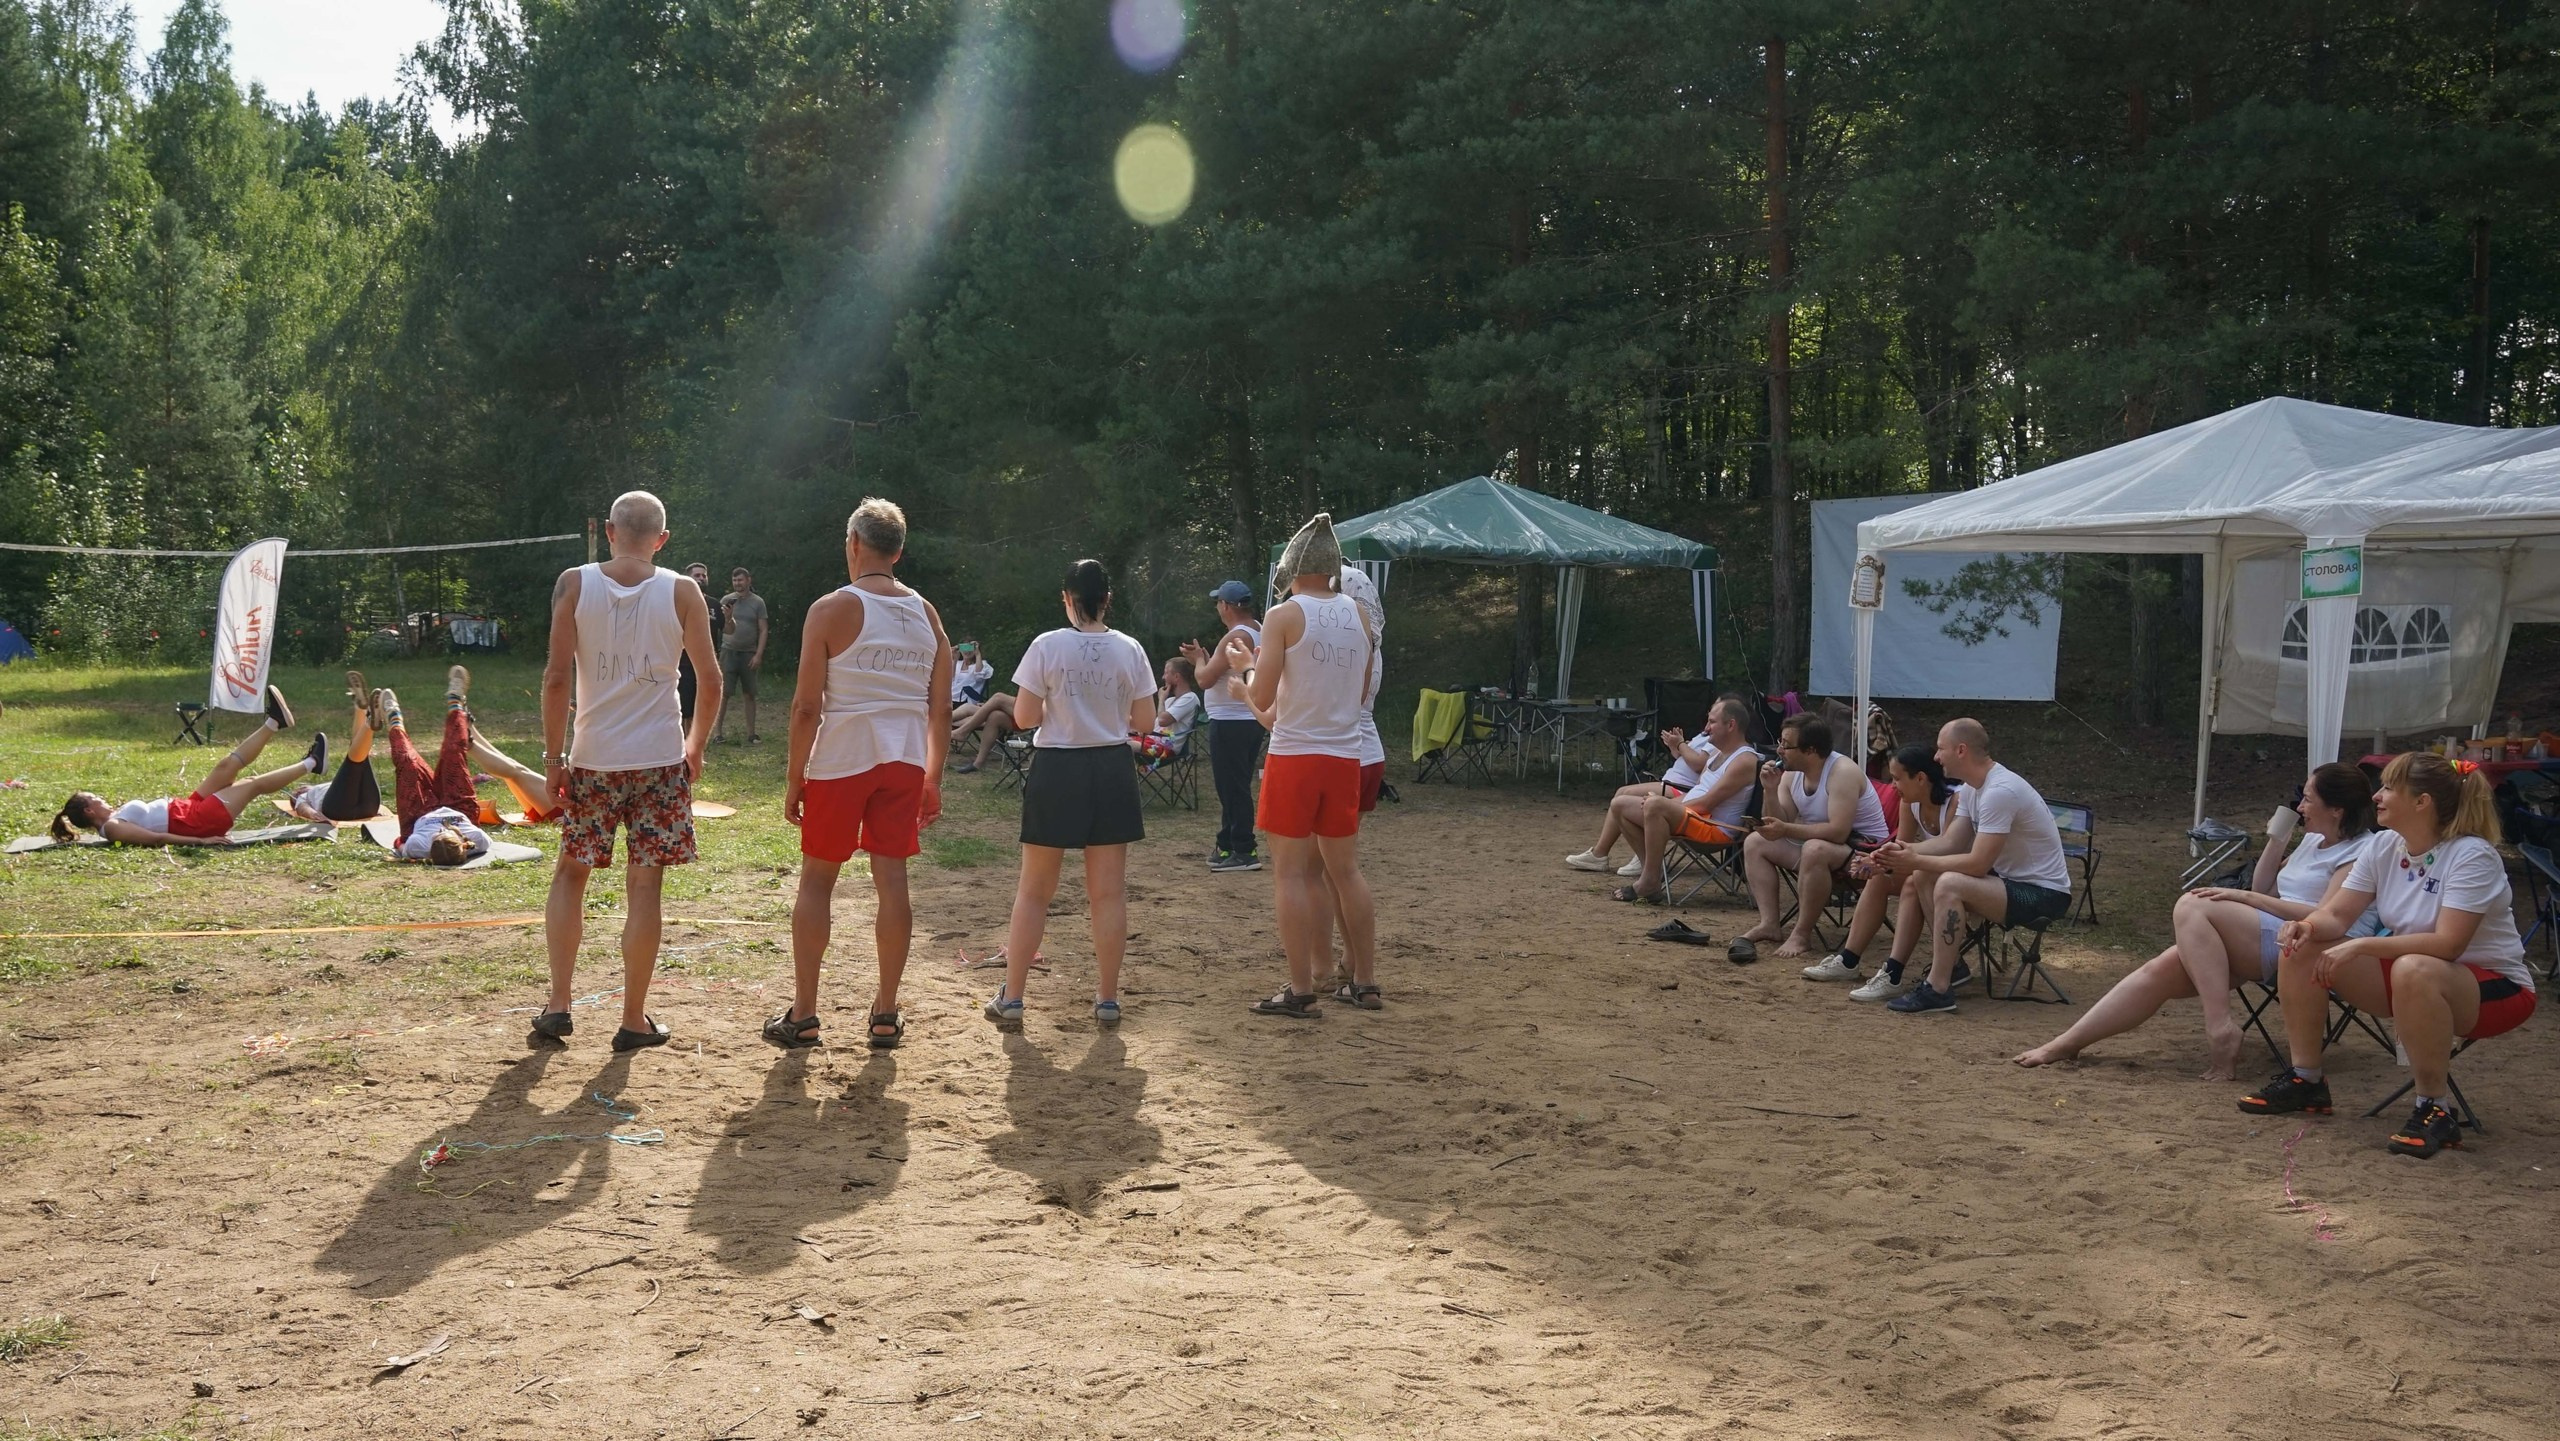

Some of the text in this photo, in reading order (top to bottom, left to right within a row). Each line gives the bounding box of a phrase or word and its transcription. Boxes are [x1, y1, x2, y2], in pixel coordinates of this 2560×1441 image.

[2303, 562, 2358, 577] СТОЛОВАЯ
[608, 598, 641, 644] 11
[888, 606, 910, 633] 7
[1078, 641, 1110, 662] 15
[1312, 641, 1357, 669] ОЛЕГ
[596, 652, 658, 686] ВЛАД
